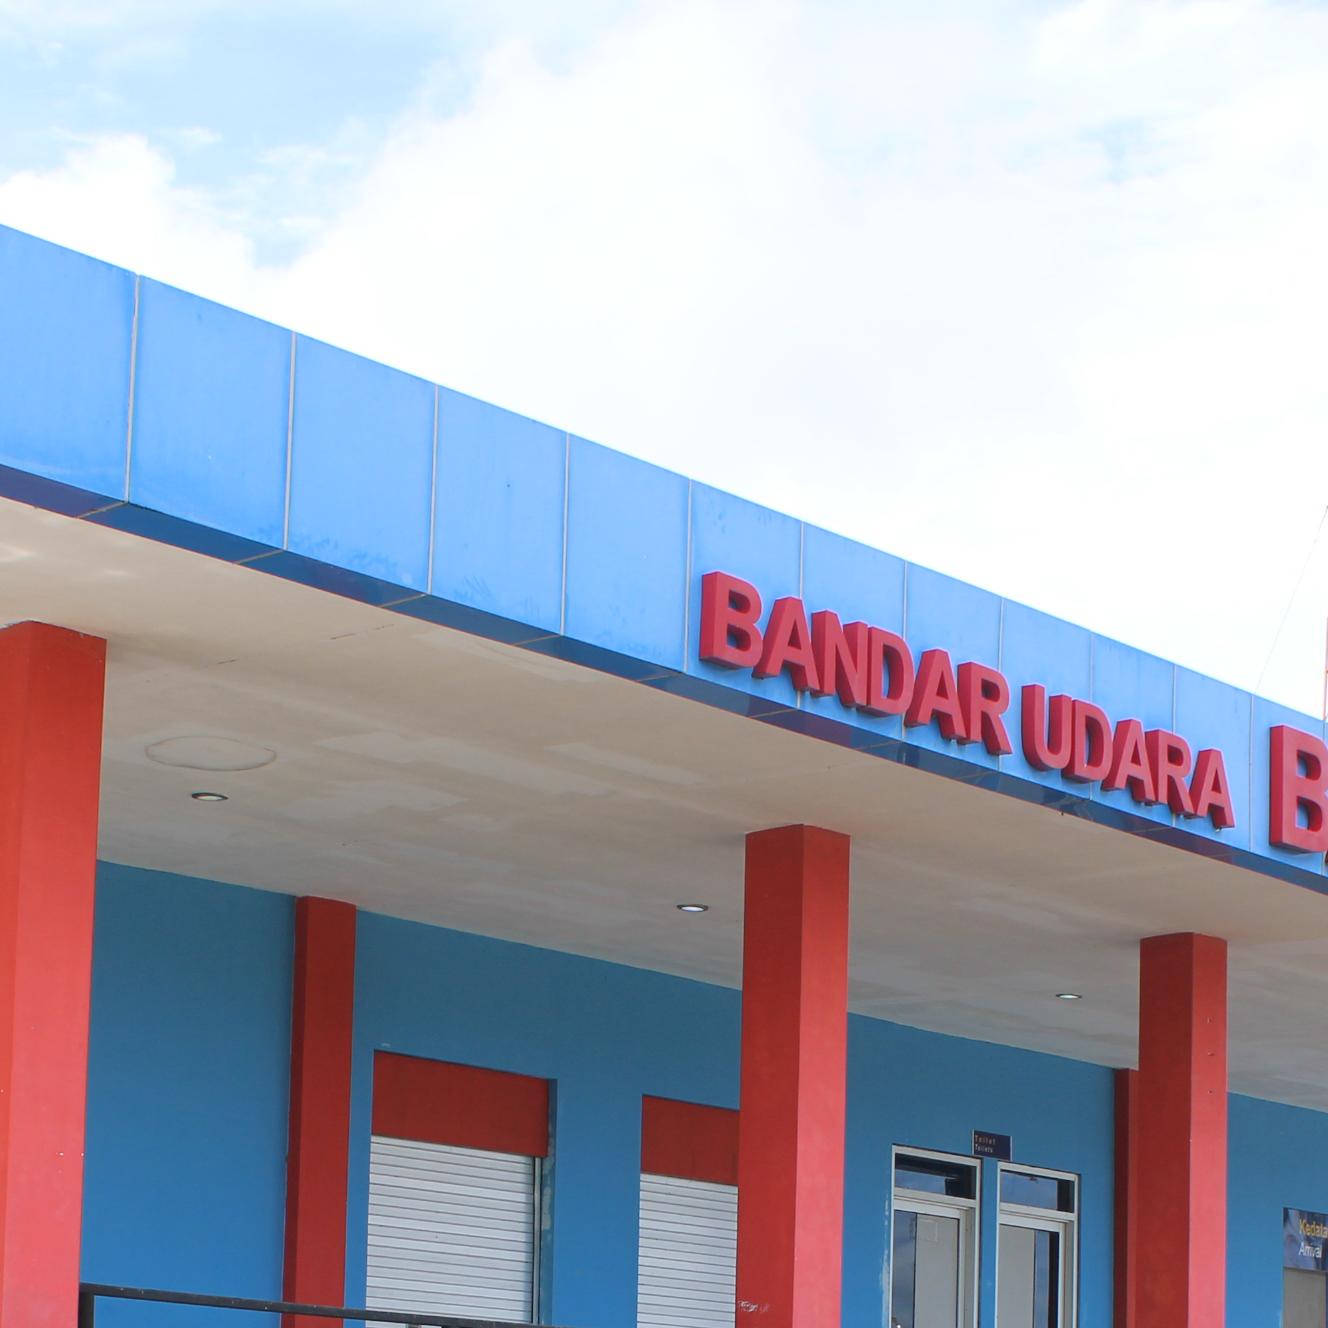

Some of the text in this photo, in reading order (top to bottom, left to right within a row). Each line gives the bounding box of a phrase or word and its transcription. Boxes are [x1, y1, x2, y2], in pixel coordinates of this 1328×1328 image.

[699, 571, 1012, 756] BANDAR
[1021, 683, 1236, 830] UDARA
[1298, 1240, 1323, 1259] Arrival
